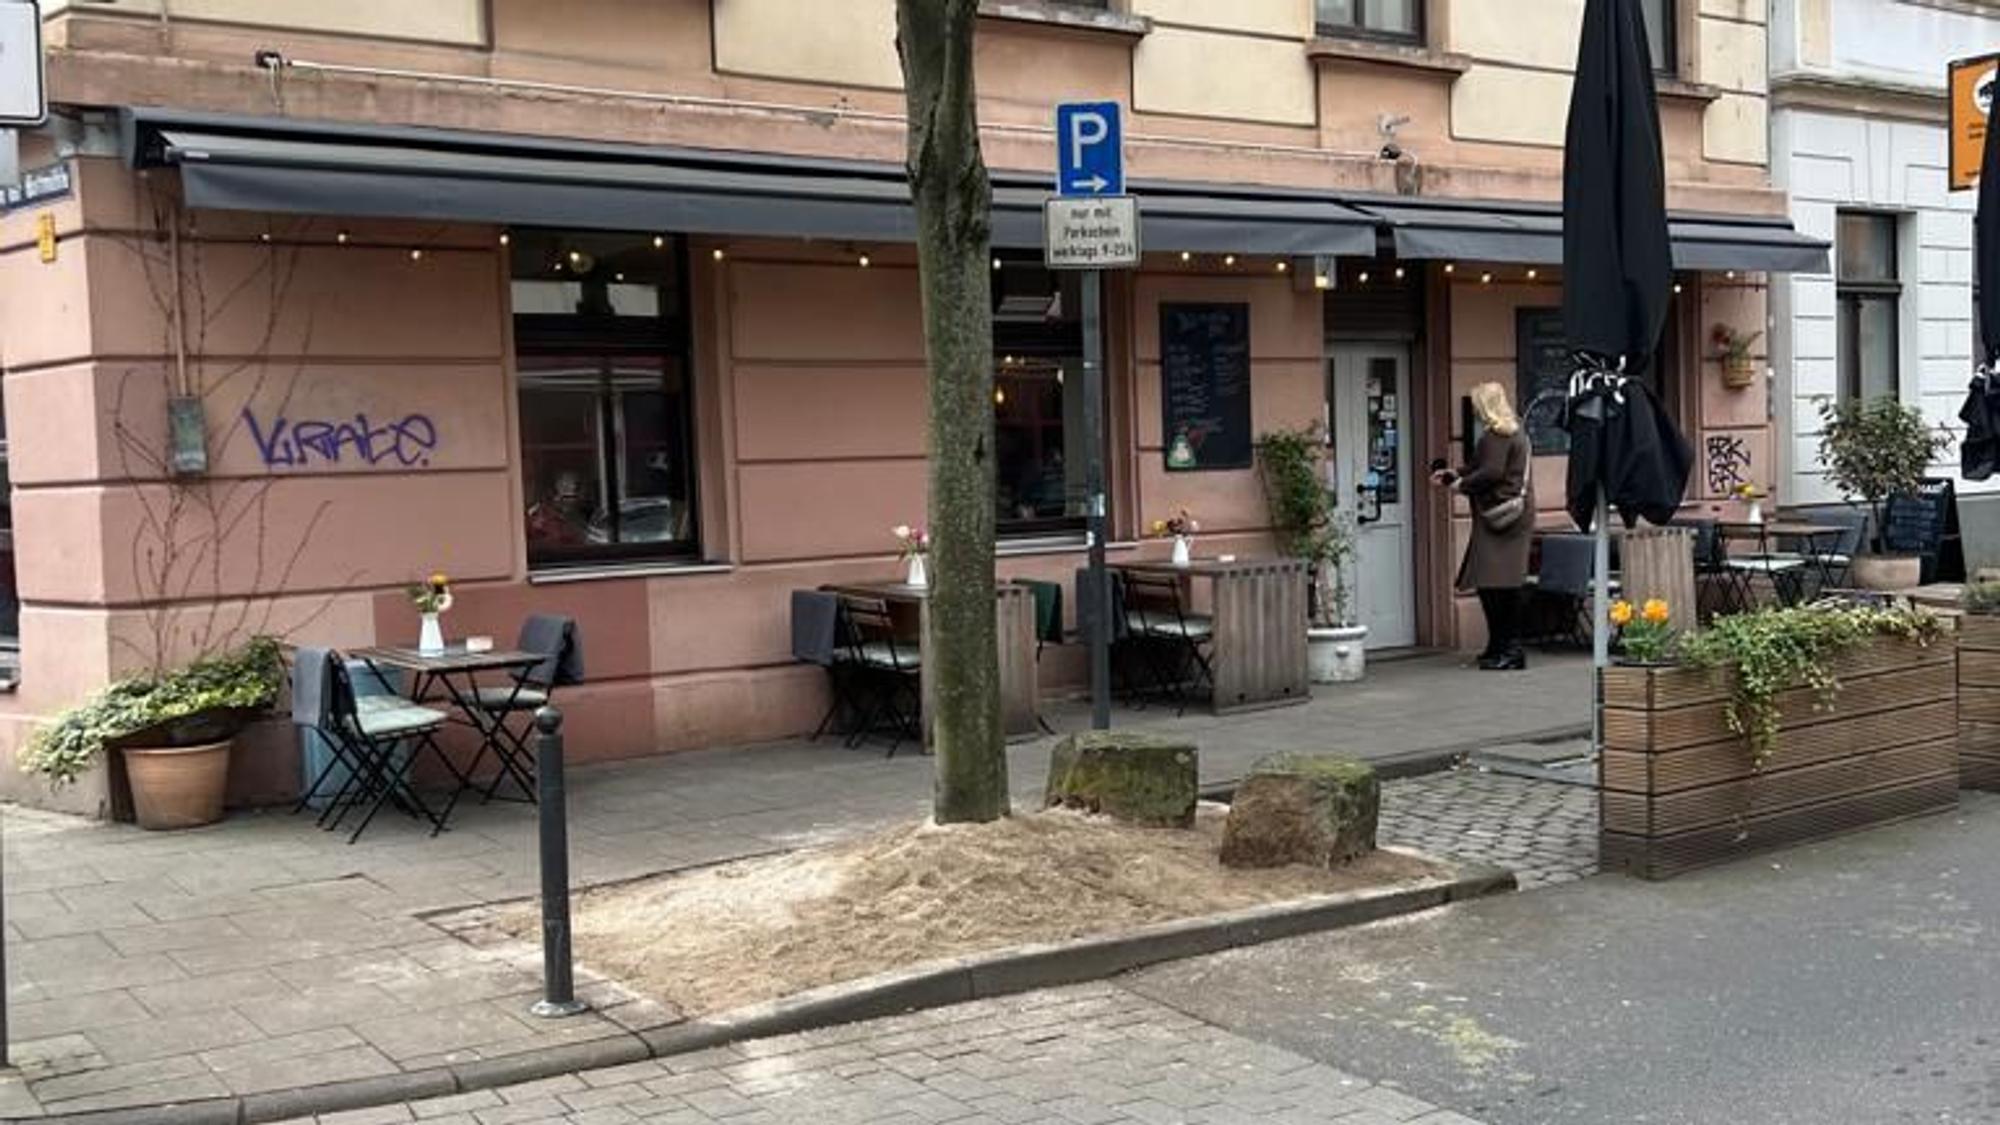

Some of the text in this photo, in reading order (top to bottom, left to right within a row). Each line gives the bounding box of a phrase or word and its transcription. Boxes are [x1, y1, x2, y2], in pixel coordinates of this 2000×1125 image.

[1070, 112, 1108, 169] P
[1070, 206, 1111, 219] nur mit
[1063, 225, 1121, 239] Parkschein
